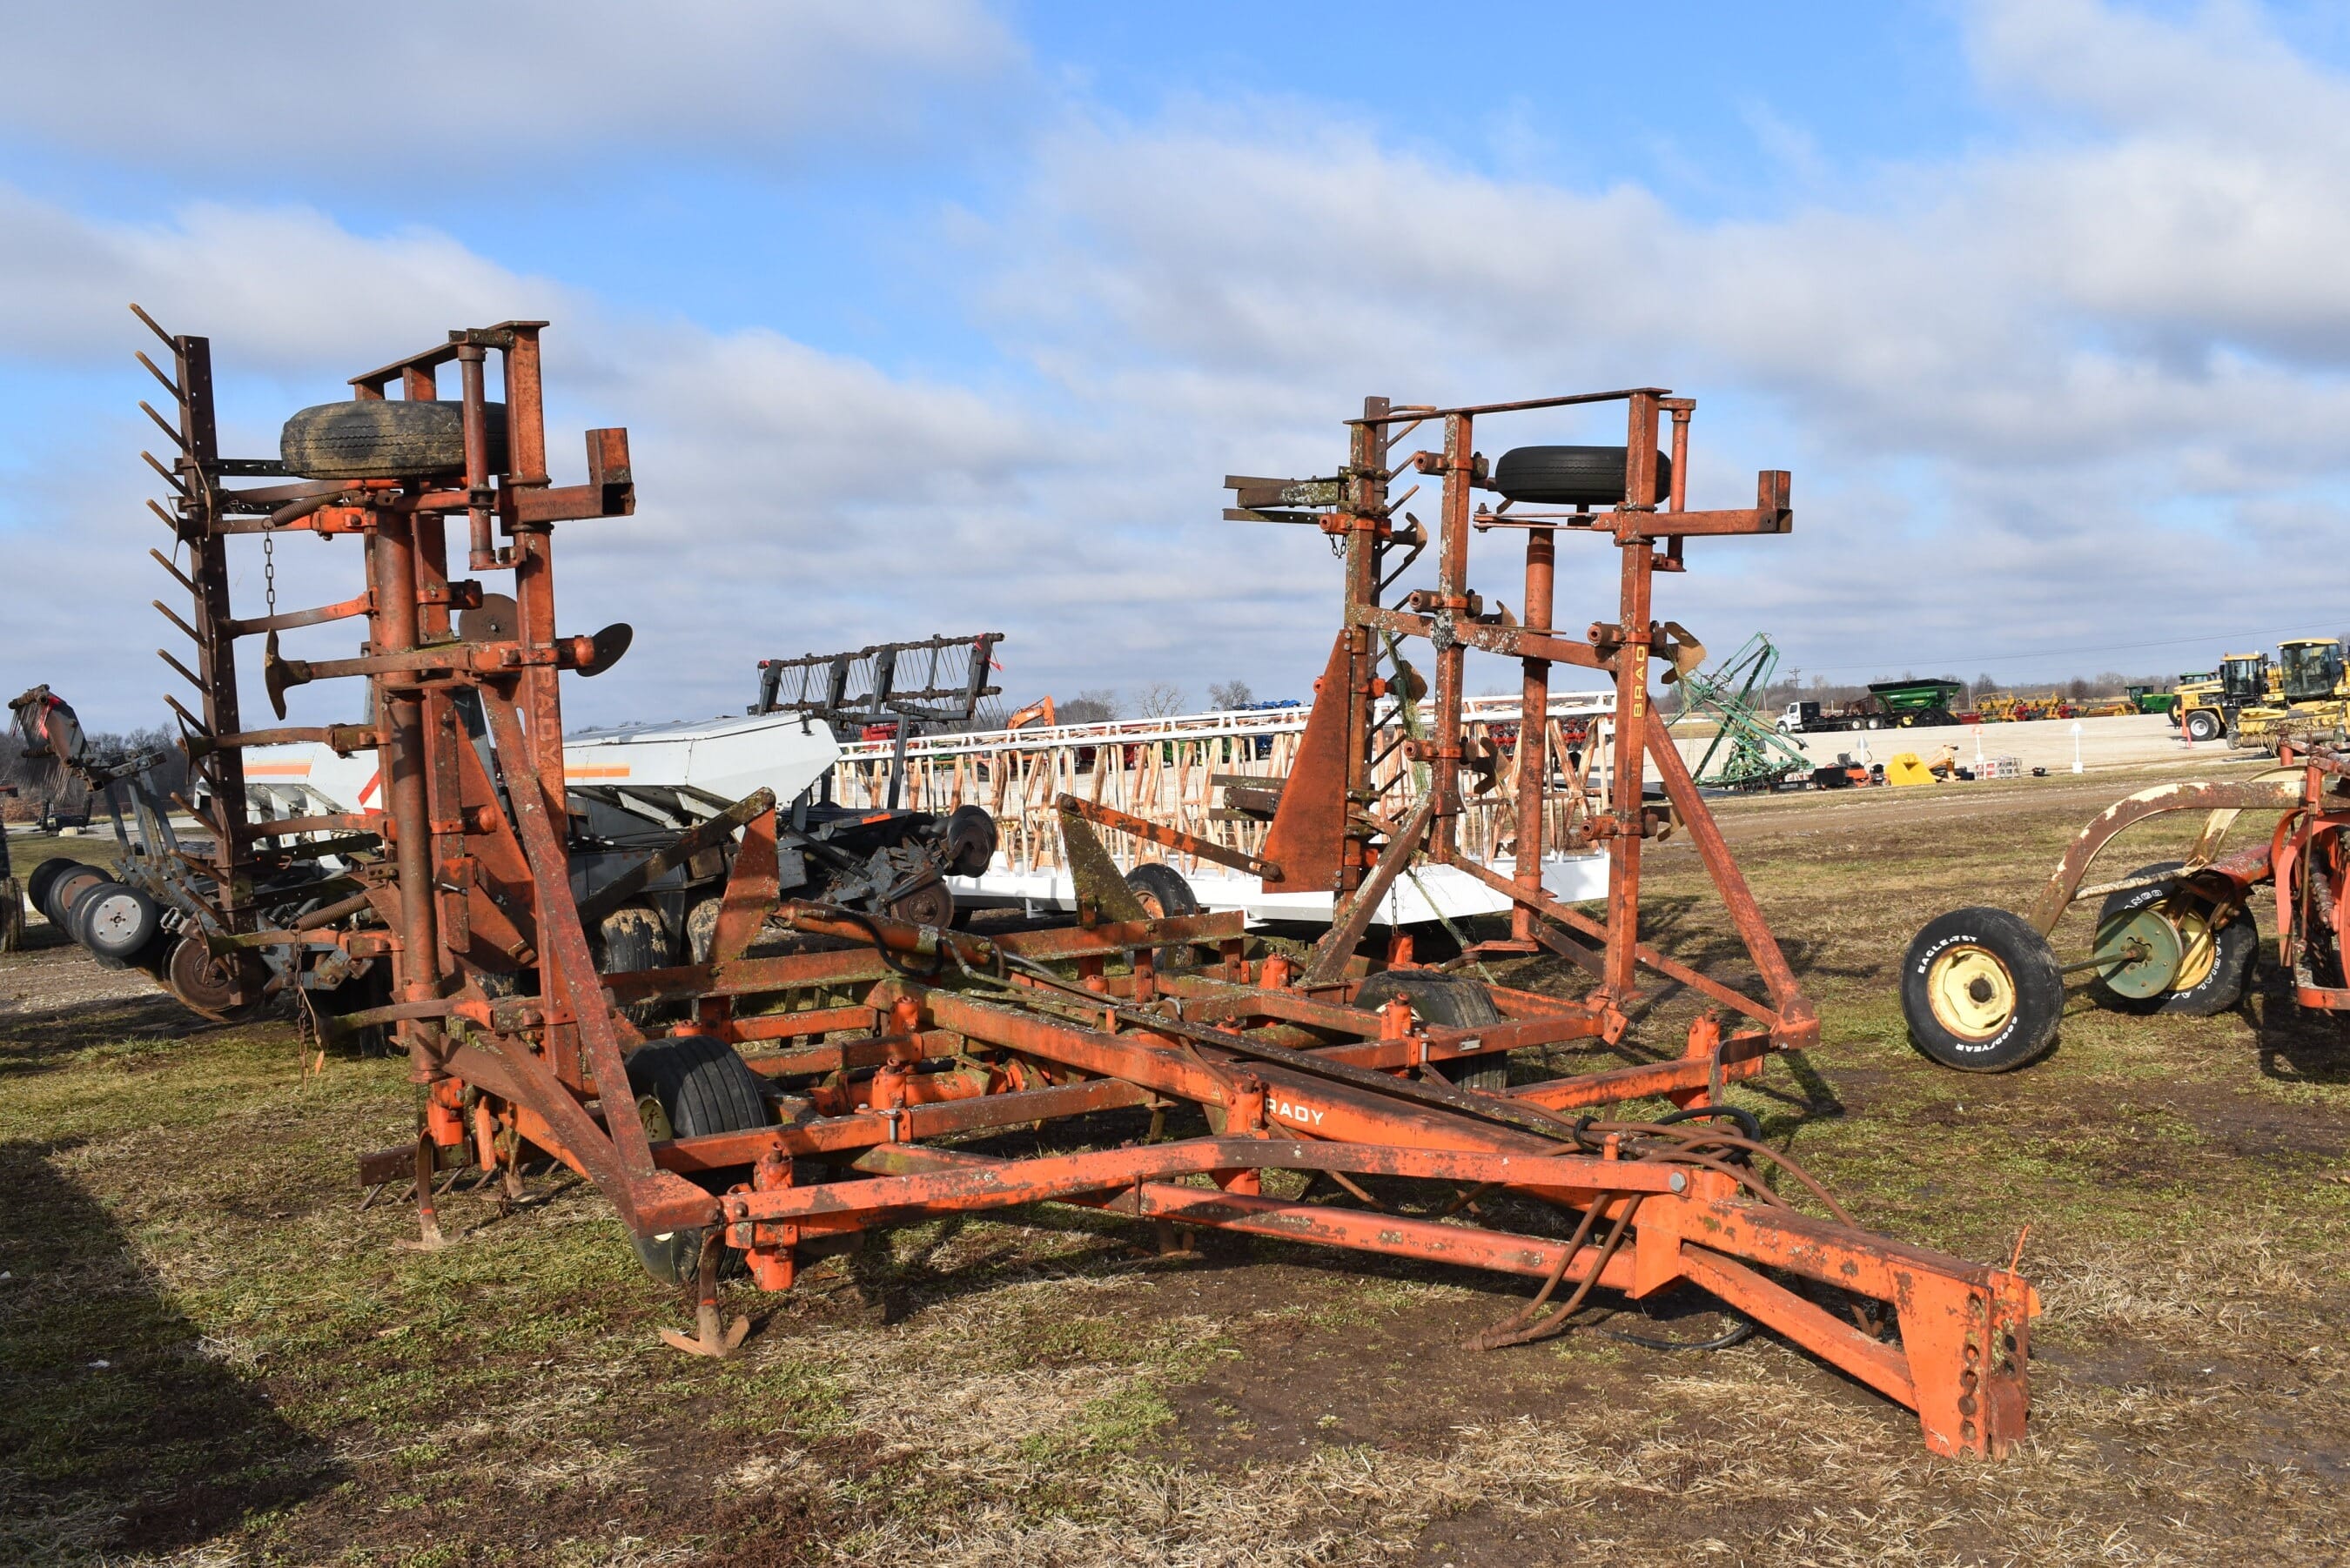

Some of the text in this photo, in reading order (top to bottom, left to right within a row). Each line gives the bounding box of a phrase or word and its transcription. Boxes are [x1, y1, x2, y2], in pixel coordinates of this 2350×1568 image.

[1633, 627, 1647, 718] BRAD
[536, 642, 559, 767] RADY
[1917, 939, 1950, 974] EAGLE
[1955, 1015, 2018, 1053] GOODYEAR
[1265, 1097, 1324, 1126] RADY
